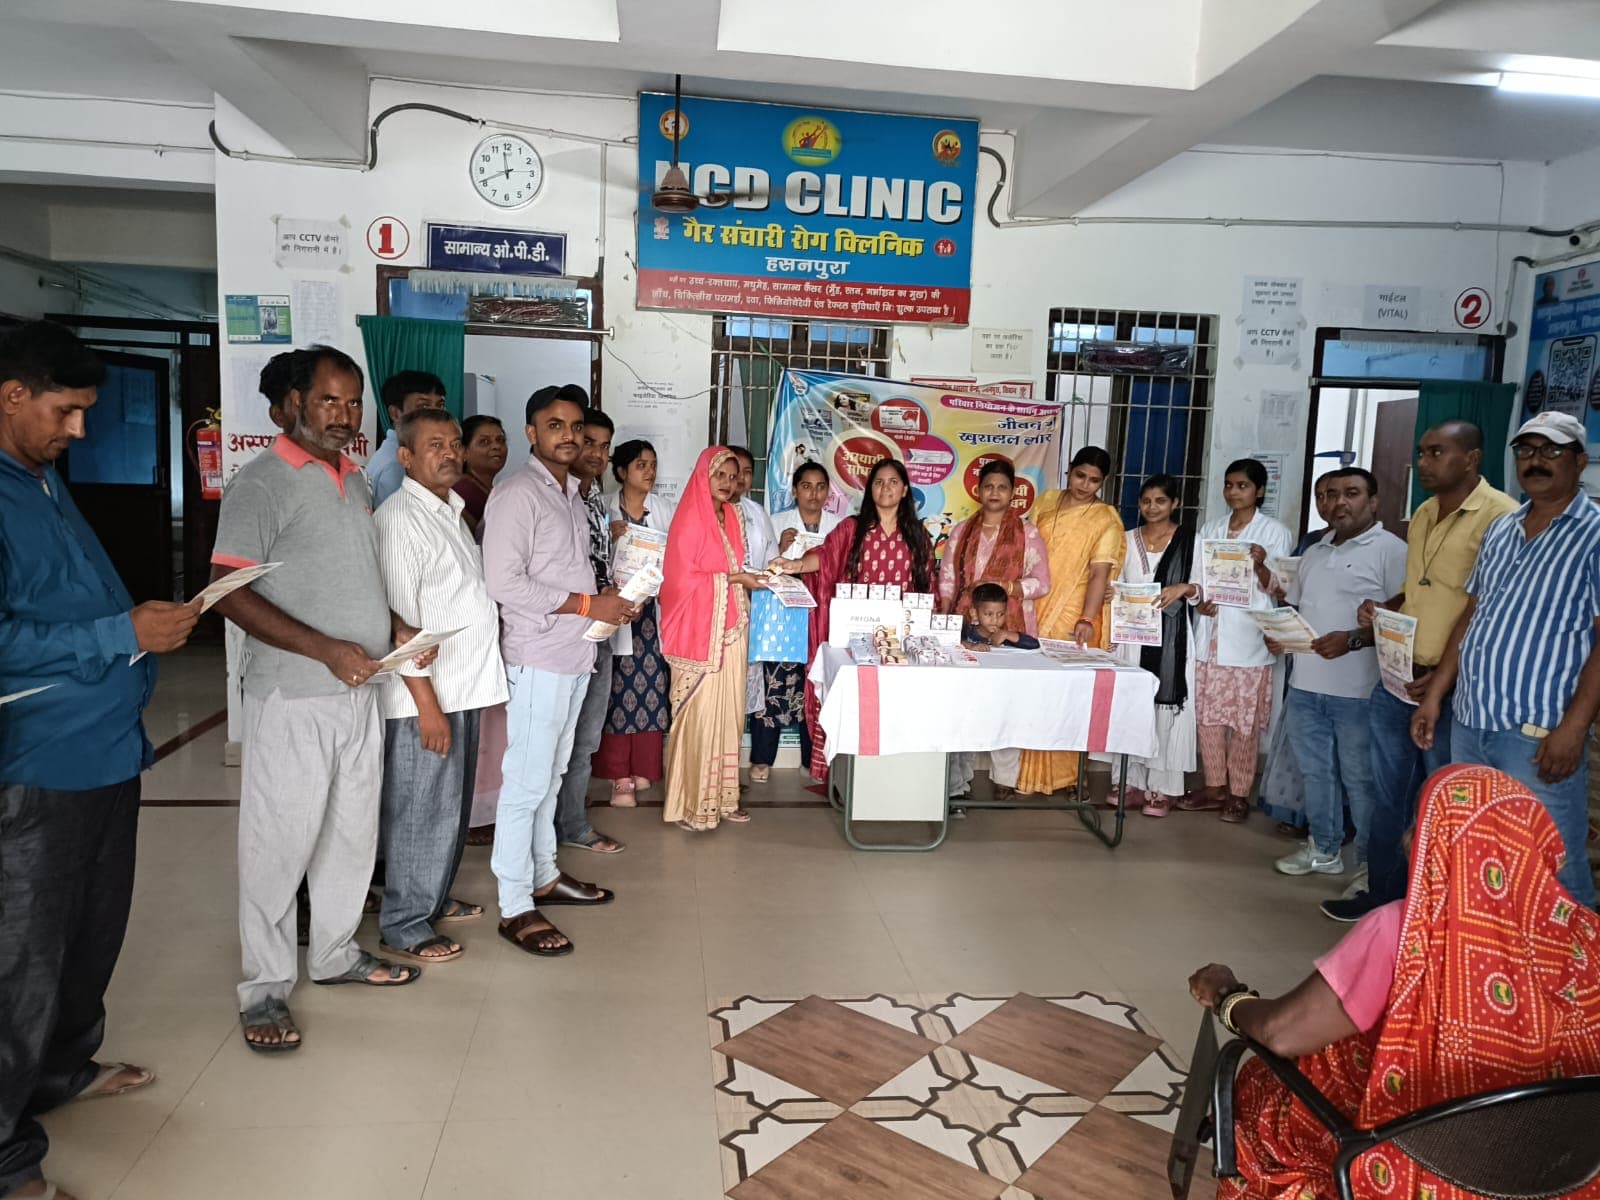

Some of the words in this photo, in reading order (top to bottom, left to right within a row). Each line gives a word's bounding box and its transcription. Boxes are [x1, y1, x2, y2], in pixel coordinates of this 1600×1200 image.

[503, 143, 512, 151] 12
[518, 147, 522, 155] 1
[481, 154, 491, 162] 10
[526, 157, 532, 165] 2
[491, 189, 497, 197] 7
[504, 193, 510, 201] 6
[785, 170, 962, 223] CLINIC
[299, 233, 321, 242] CCTV
[378, 224, 394, 253] 1
[683, 216, 716, 244] गैर
[720, 220, 786, 249] संचारी
[791, 224, 829, 252] रोग
[835, 228, 924, 257] क्लिनिक
[443, 240, 491, 256] सामान्य
[493, 239, 550, 262] ओ.पी.डी.
[765, 256, 851, 280] हसनपुरा
[772, 281, 802, 292] सामान्य
[1378, 308, 1408, 320] (VITAL)
[1460, 294, 1482, 324] 2
[949, 398, 974, 408] परिवार
[998, 417, 1041, 430] जीवन
